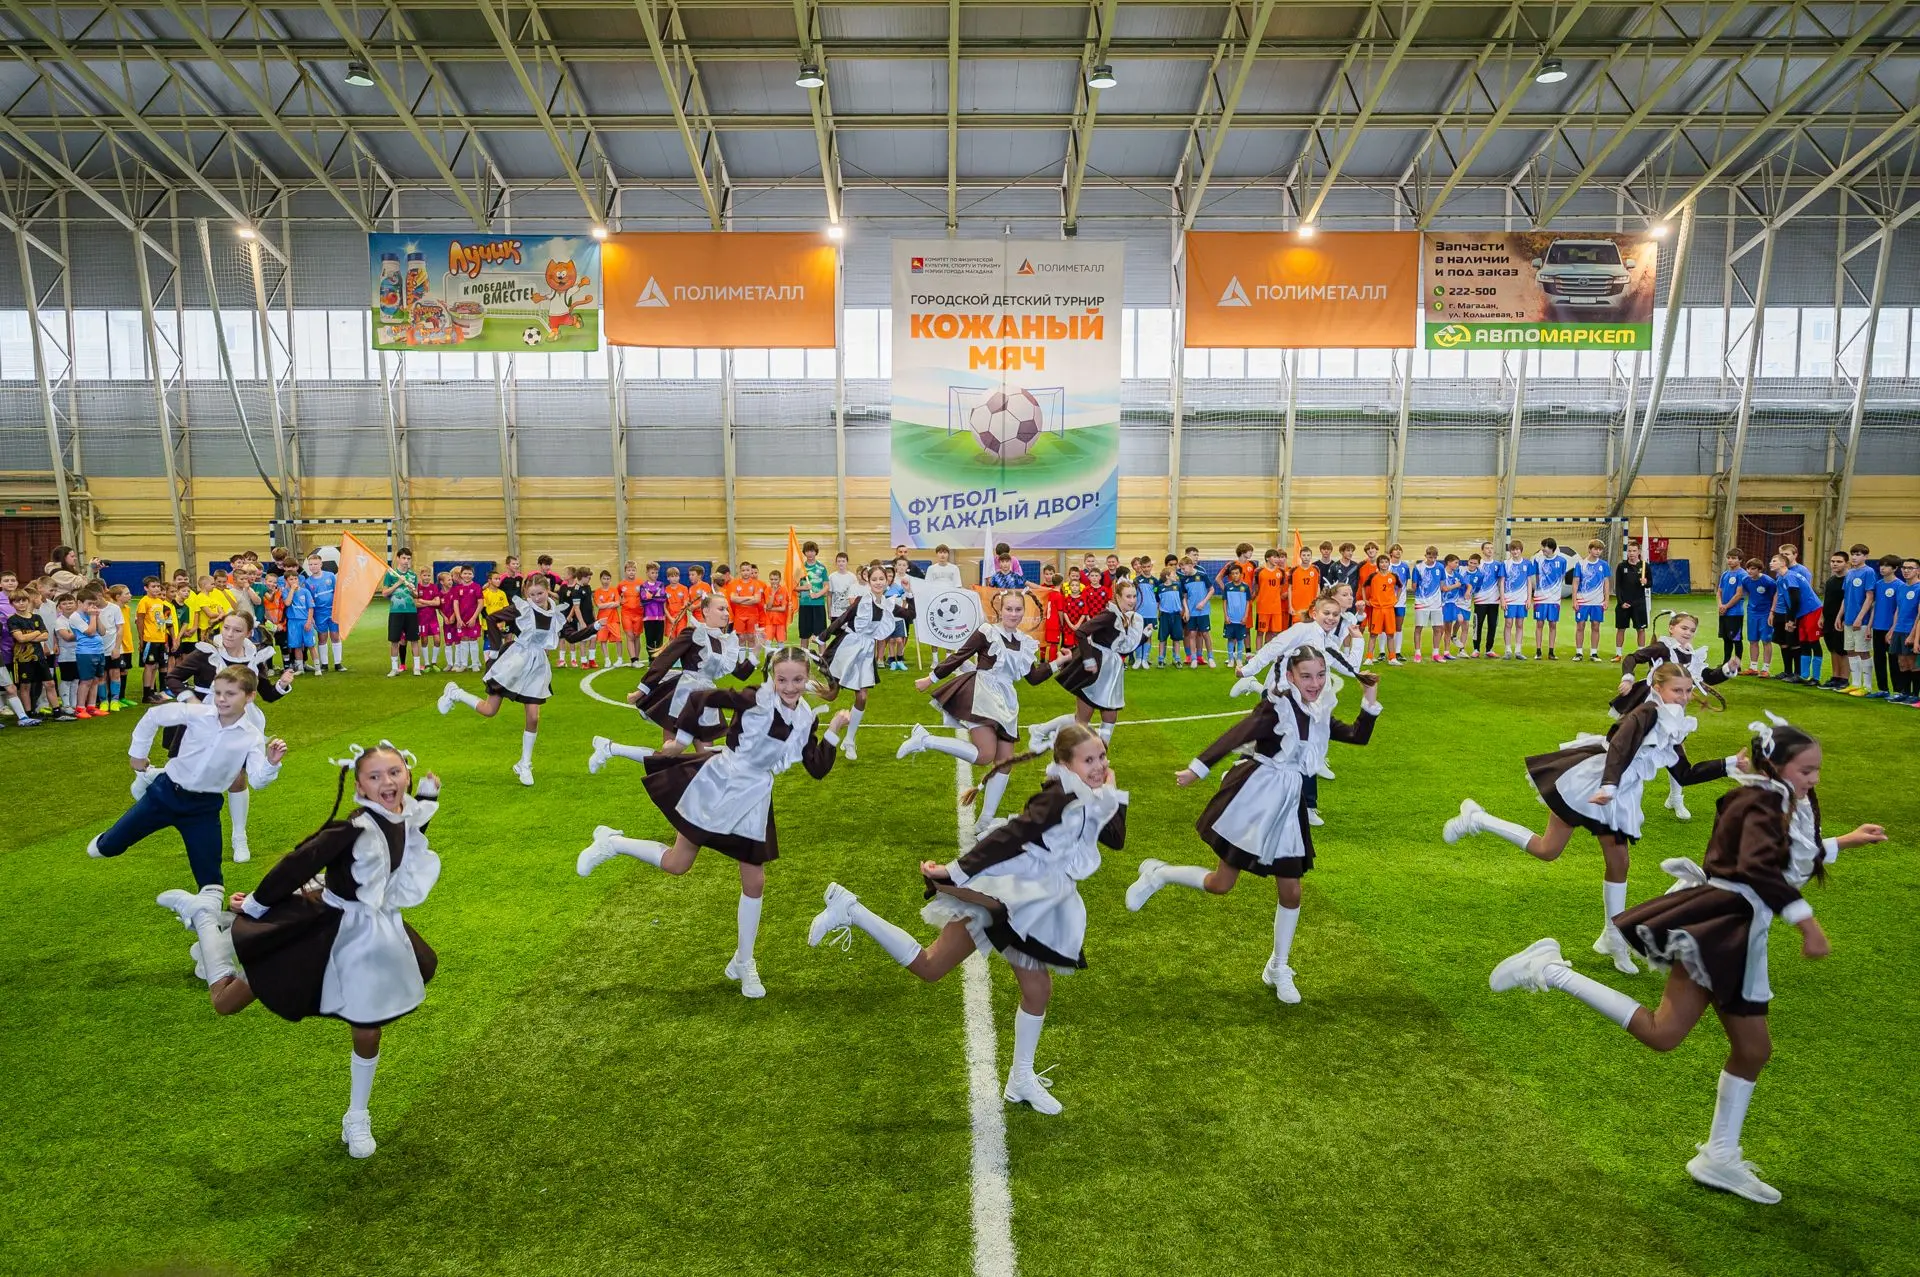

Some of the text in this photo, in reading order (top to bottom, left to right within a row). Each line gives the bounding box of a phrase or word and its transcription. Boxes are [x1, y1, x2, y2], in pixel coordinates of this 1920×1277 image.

[1436, 242, 1504, 251] Запчасти
[449, 240, 522, 278] Лучик
[1037, 264, 1104, 273] ПОЛИМЕТАЛЛ
[464, 280, 515, 295] К ПОБЕДАМ
[674, 286, 804, 300] ПОЛИМЕТАЛЛ
[1256, 285, 1387, 300] ПОЛИМЕТАЛЛ
[483, 288, 534, 305] ВМЕСТЕ!
[911, 293, 1104, 307] ГОРОДСКОЙ ДЕТСКИЙ ТУРНИР
[910, 308, 1104, 340] КОЖАНЫЙ
[969, 346, 1045, 370] МЯЧ
[908, 488, 997, 516] ФУТБОЛ
[908, 492, 1100, 535] В КАЖДЫЙ ДВОР!
[1268, 579, 1276, 587] 10
[930, 612, 970, 640] КОЖАНЫЙ МЯЧ
